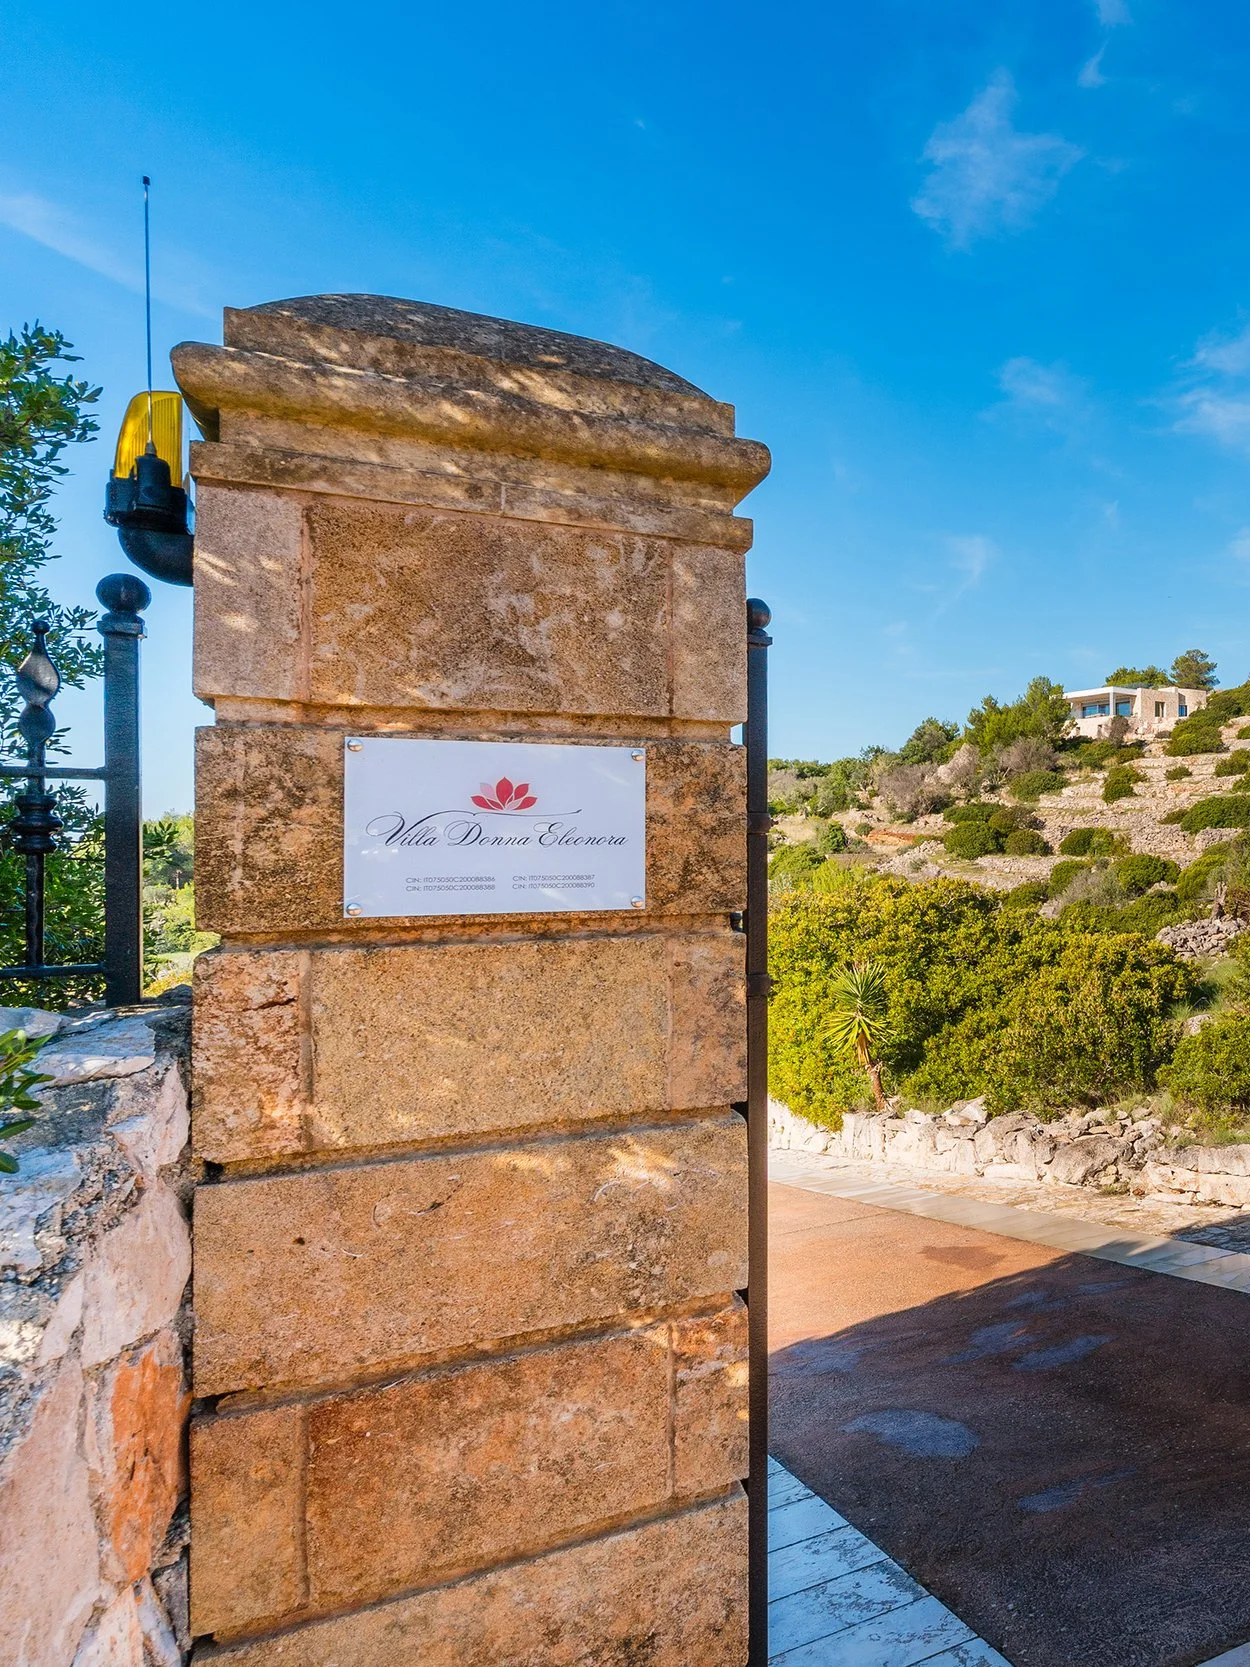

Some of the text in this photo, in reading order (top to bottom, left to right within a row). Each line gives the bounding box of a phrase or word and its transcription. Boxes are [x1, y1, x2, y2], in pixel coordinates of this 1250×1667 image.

[365, 811, 628, 848] Villa Donna Eleonora
